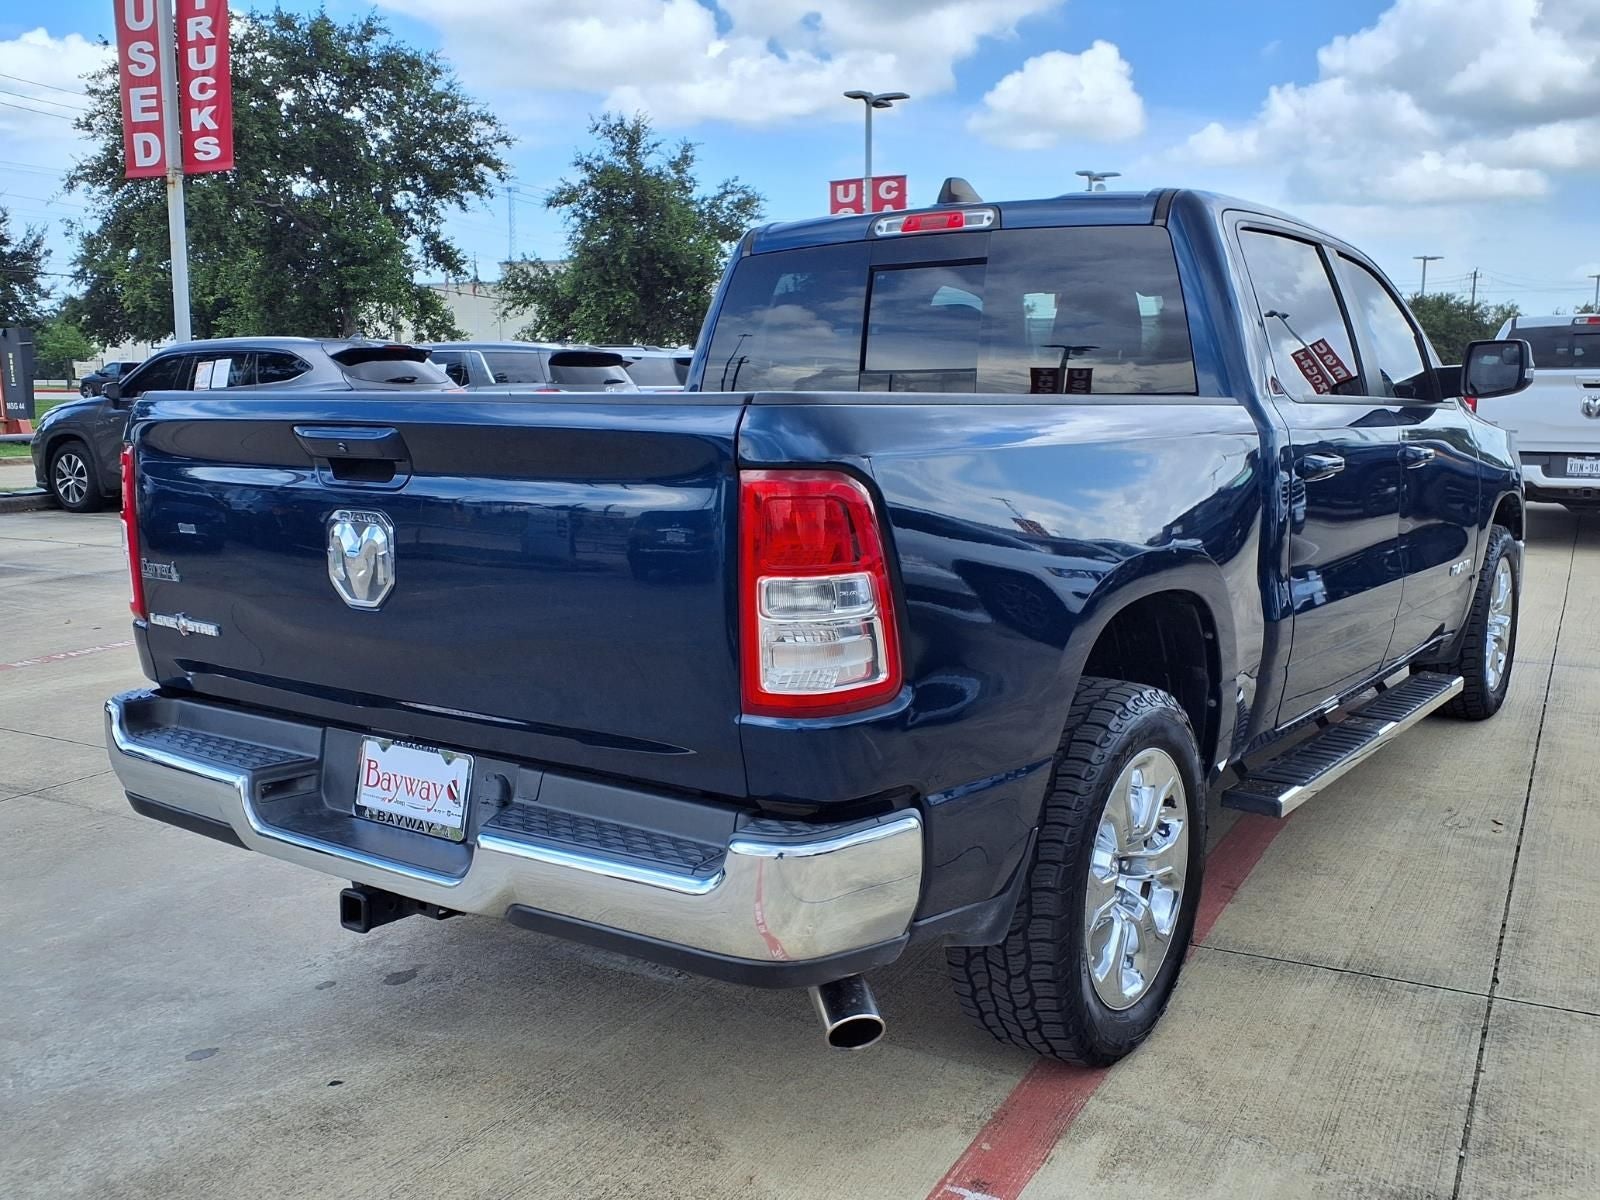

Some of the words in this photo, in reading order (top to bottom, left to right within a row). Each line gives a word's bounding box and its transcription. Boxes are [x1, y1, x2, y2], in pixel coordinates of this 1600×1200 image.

[125, 0, 162, 167] USED
[364, 758, 444, 813] Bayway
[376, 810, 435, 833] BAYWAY
